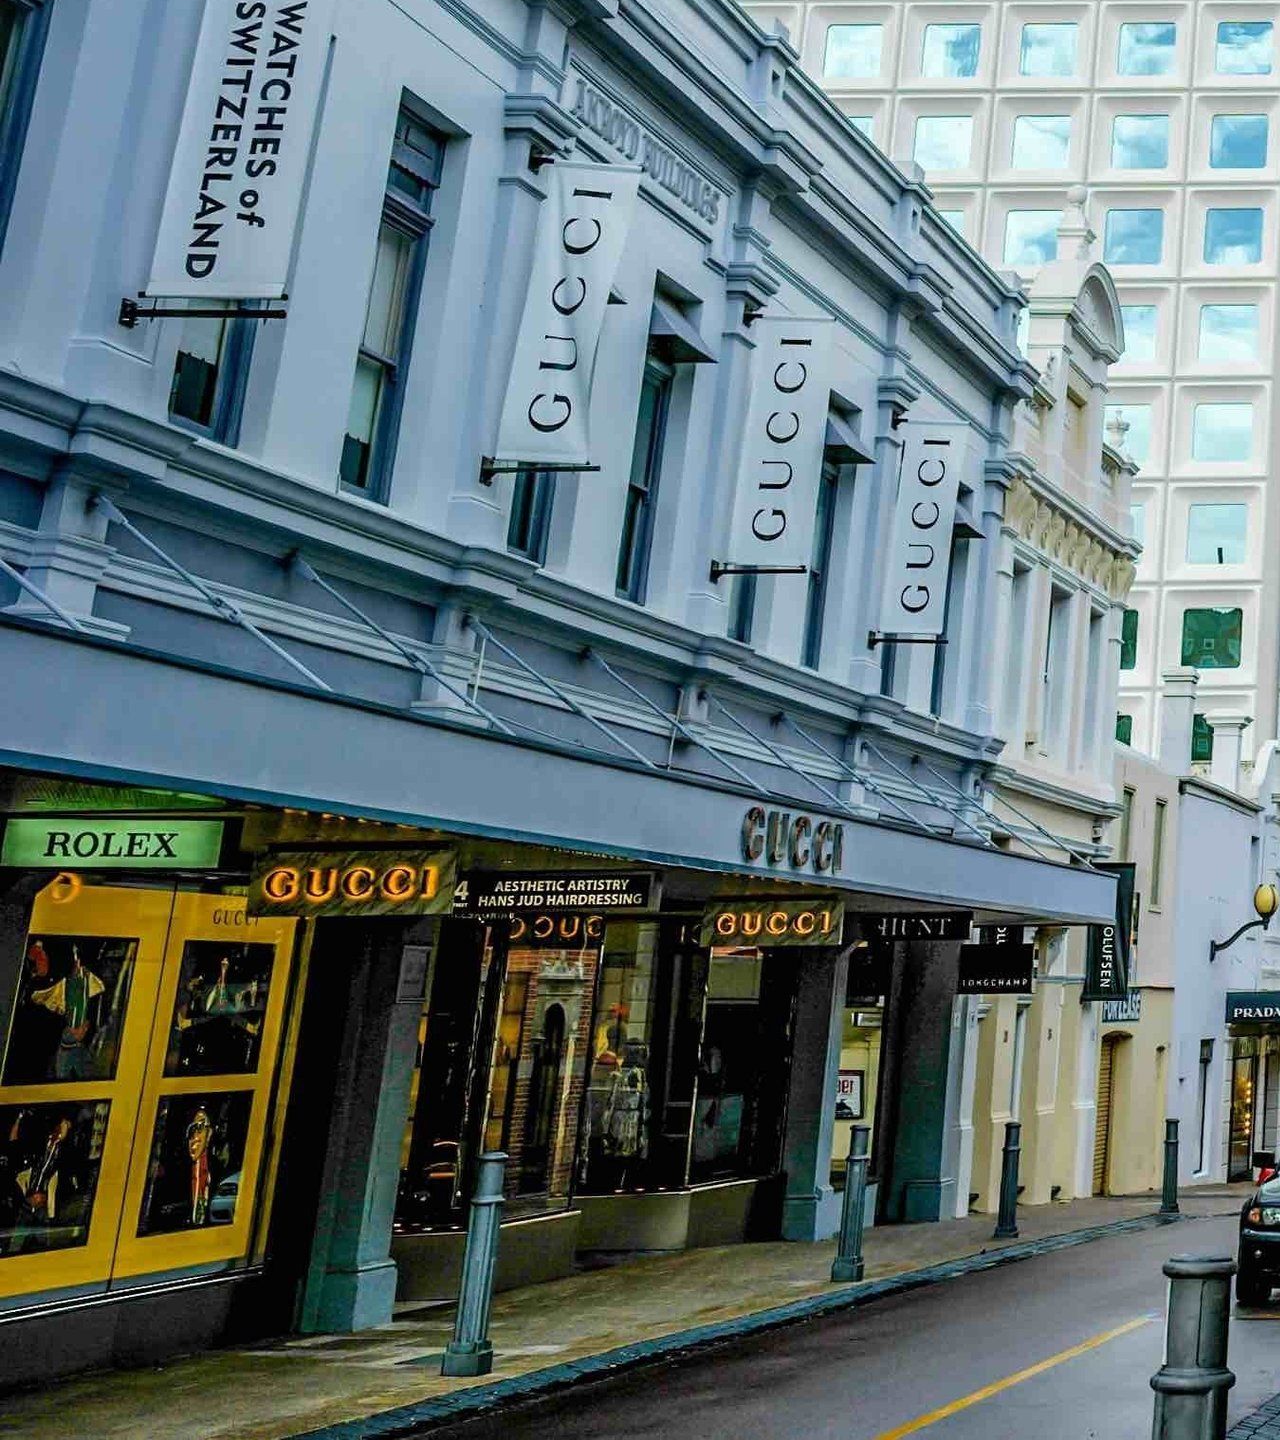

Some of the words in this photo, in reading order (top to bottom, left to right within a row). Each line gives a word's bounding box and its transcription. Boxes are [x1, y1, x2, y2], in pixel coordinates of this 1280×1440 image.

[246, 0, 308, 178] WATCHES
[184, 1, 266, 279] SWITZERLAND
[236, 191, 266, 228] of
[528, 188, 614, 433] GUCCI
[751, 337, 812, 542] GUCCI
[900, 438, 953, 614] GUCCI
[43, 831, 179, 858] ROLEX
[739, 805, 844, 876] GUCCI
[263, 866, 439, 903] GUCCI
[478, 895, 515, 907] HANS
[517, 895, 544, 907] JUD
[546, 893, 643, 907] HAIRDRESSING
[494, 880, 565, 892] AESTHETIC
[567, 879, 630, 892] ARTISTRY
[715, 912, 832, 936] GUCCI
[1099, 926, 1114, 988] OLUFSEN
